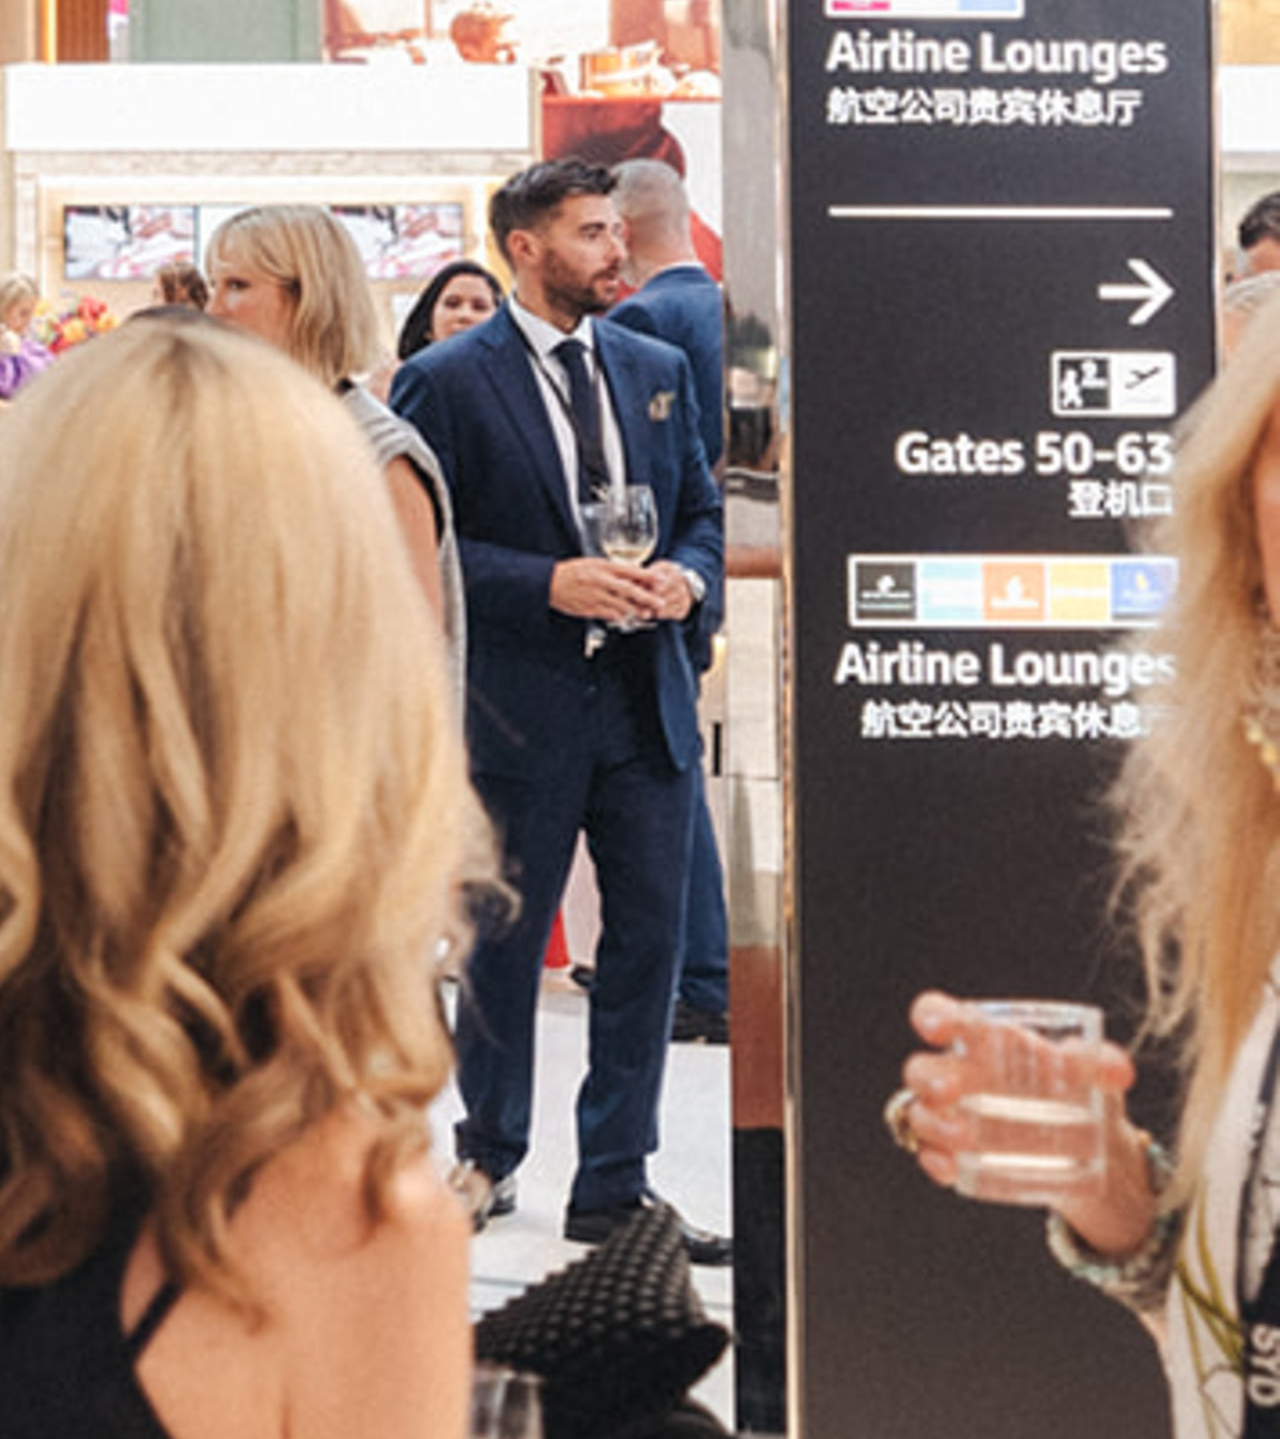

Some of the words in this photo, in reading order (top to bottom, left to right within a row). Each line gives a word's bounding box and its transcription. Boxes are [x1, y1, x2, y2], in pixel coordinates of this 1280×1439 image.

[825, 29, 971, 73] Airline
[980, 31, 1169, 84] Lounges
[827, 88, 1143, 127] 航空公司贵宾休息厅
[895, 431, 1025, 474] Gates
[1036, 431, 1174, 474] 50-63
[1067, 478, 1174, 517] 登机口
[834, 641, 981, 685] Airline
[990, 642, 1176, 696] Lounges
